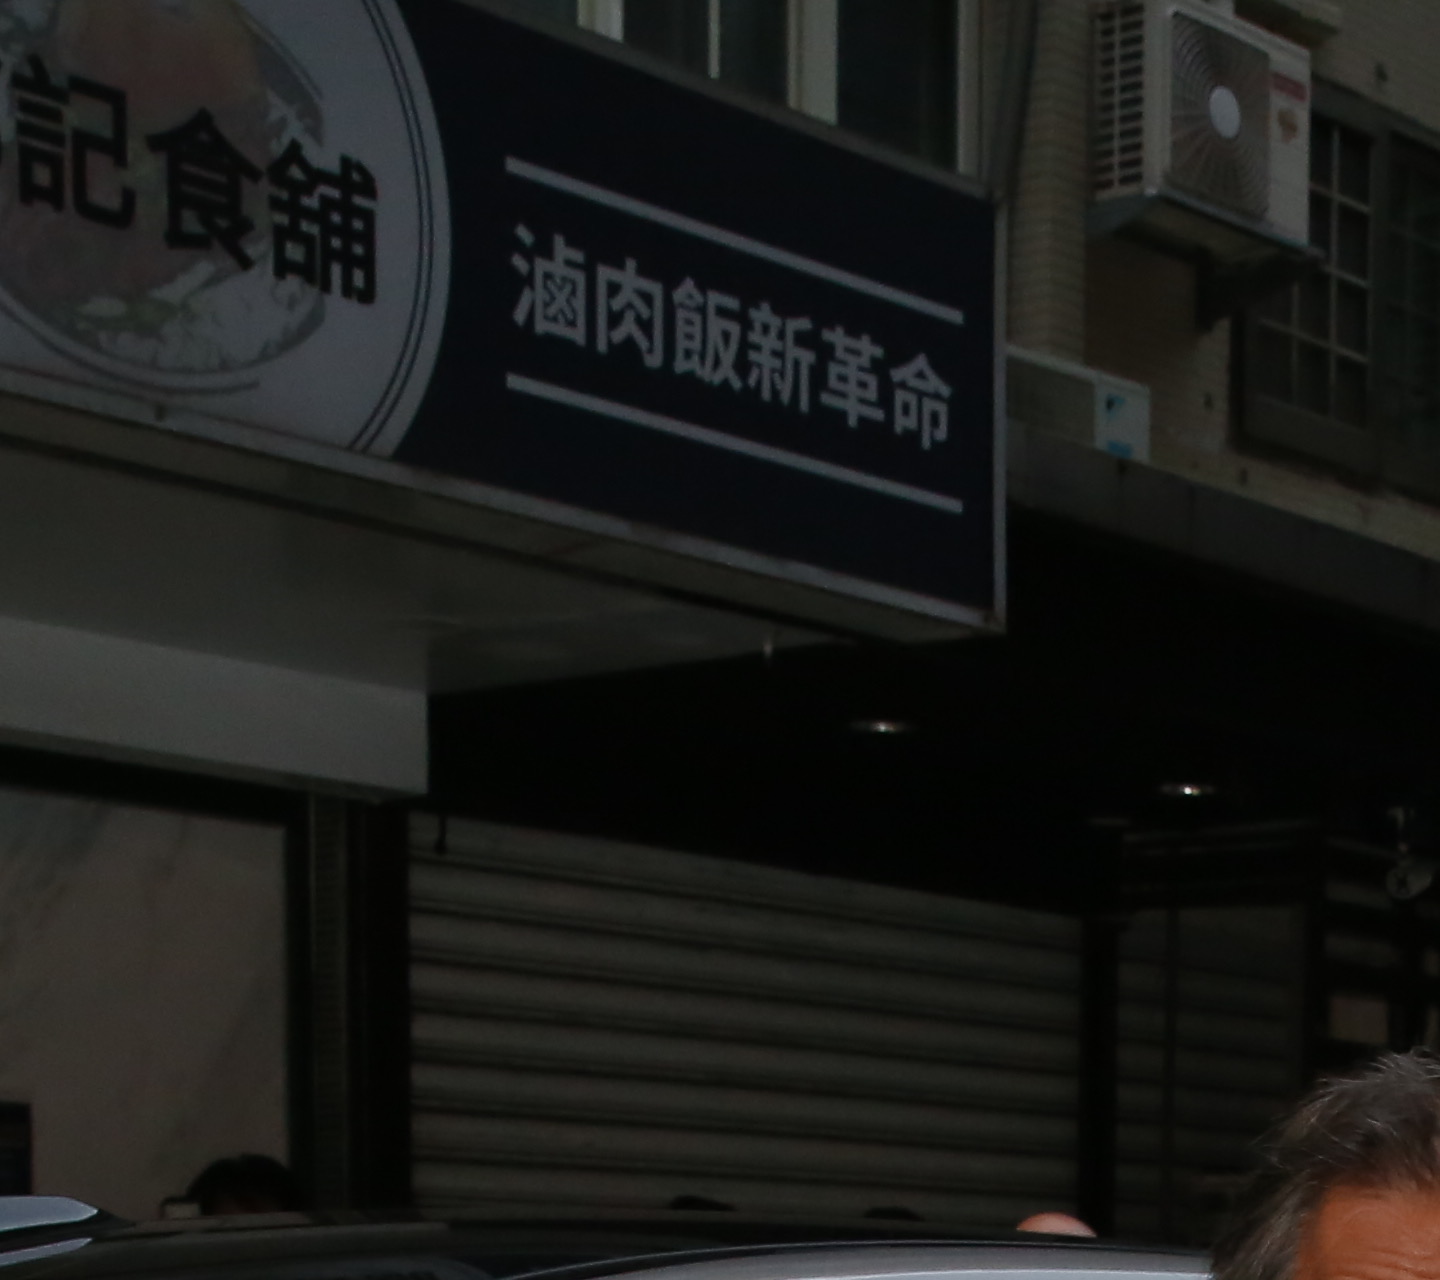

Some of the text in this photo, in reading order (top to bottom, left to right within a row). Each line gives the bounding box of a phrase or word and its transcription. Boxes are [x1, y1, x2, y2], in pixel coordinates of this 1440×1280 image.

[511, 222, 953, 450] 滷肉飯新革命
